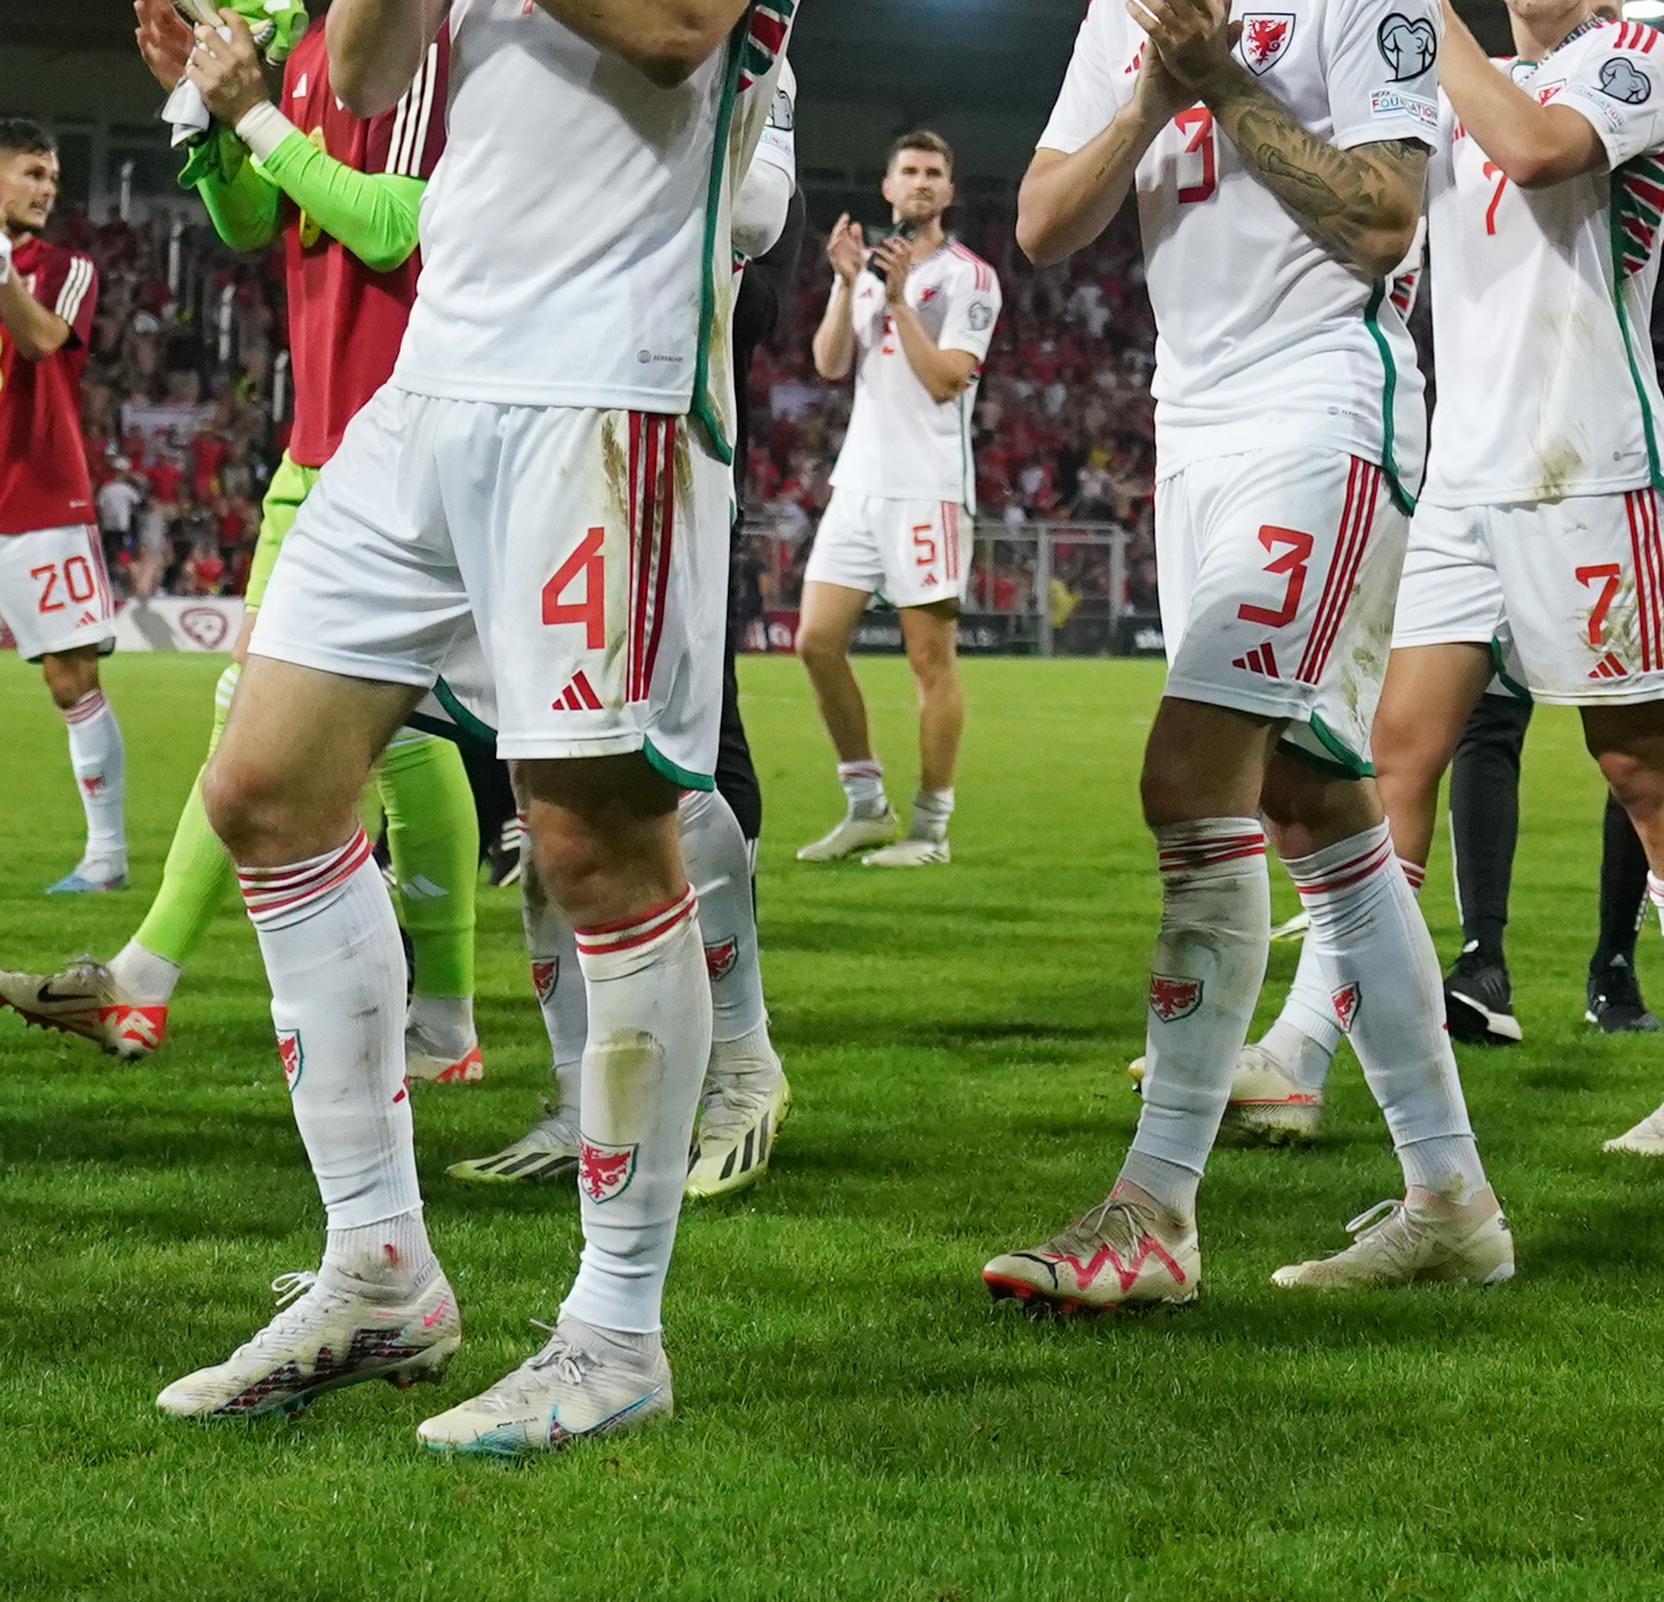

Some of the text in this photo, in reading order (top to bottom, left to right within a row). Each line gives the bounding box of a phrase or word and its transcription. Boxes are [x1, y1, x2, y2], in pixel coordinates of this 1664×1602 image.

[1174, 107, 1216, 204] 3
[30, 555, 95, 613] 20
[541, 526, 605, 650] 4
[912, 524, 936, 567] 5
[1237, 524, 1315, 629] 3
[1575, 563, 1621, 645] 7
